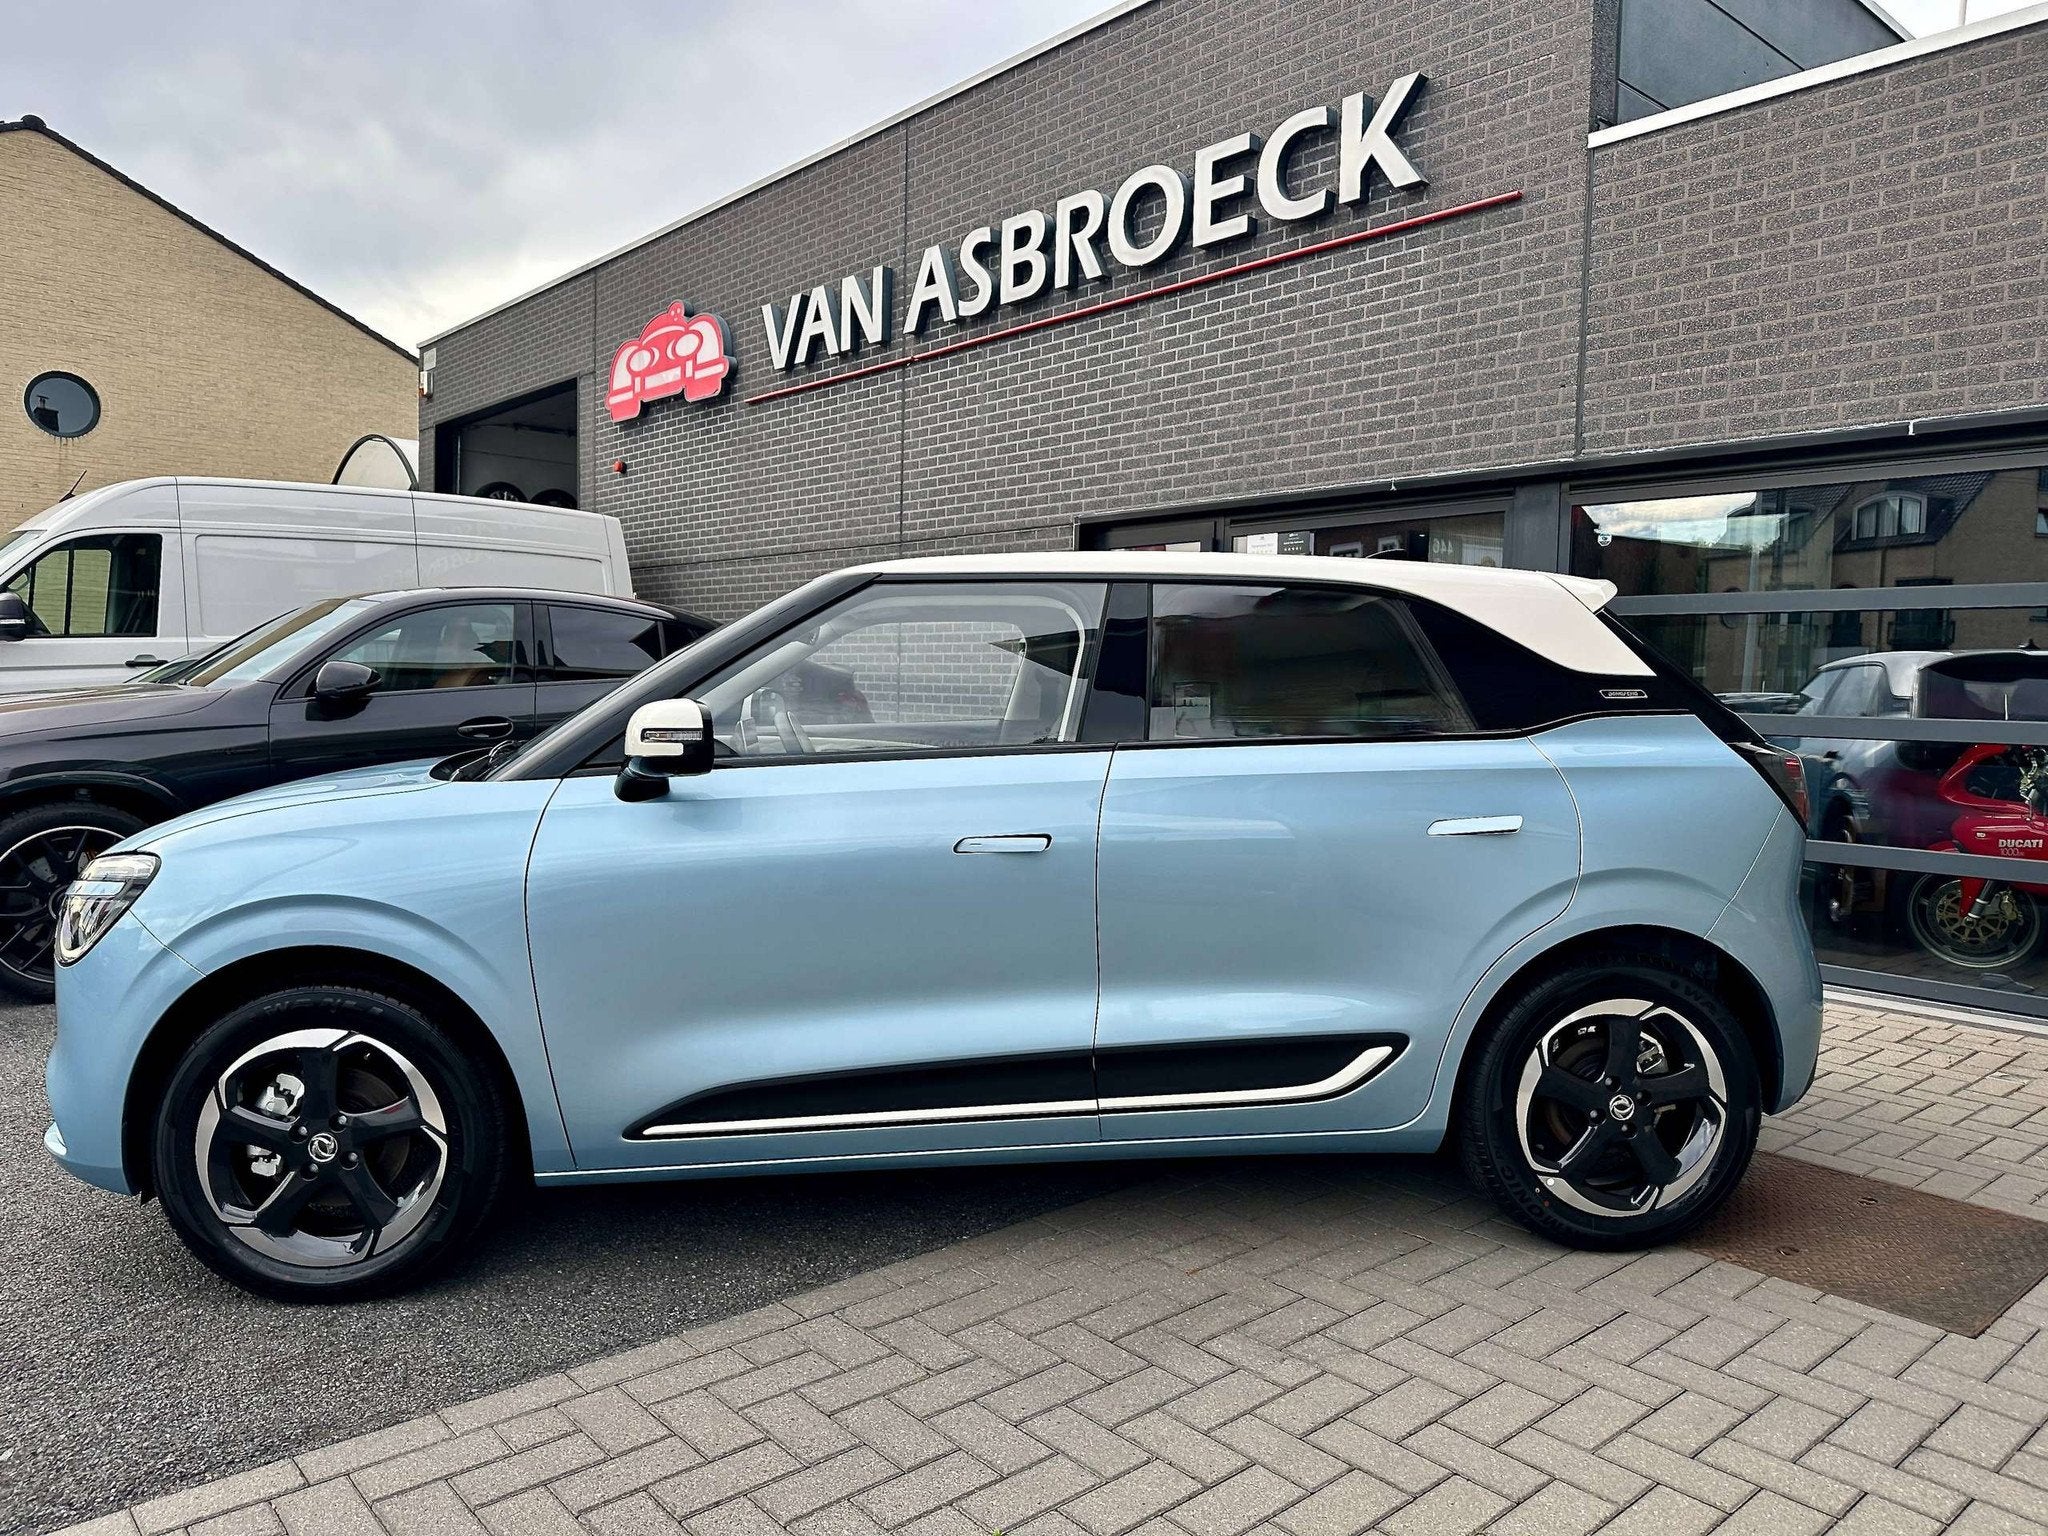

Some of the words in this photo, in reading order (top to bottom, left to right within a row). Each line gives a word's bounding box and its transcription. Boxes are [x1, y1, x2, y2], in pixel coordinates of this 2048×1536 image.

[761, 264, 891, 370] VAN
[903, 71, 1427, 334] ASBROECK
[1998, 838, 2044, 849] DUCATI
